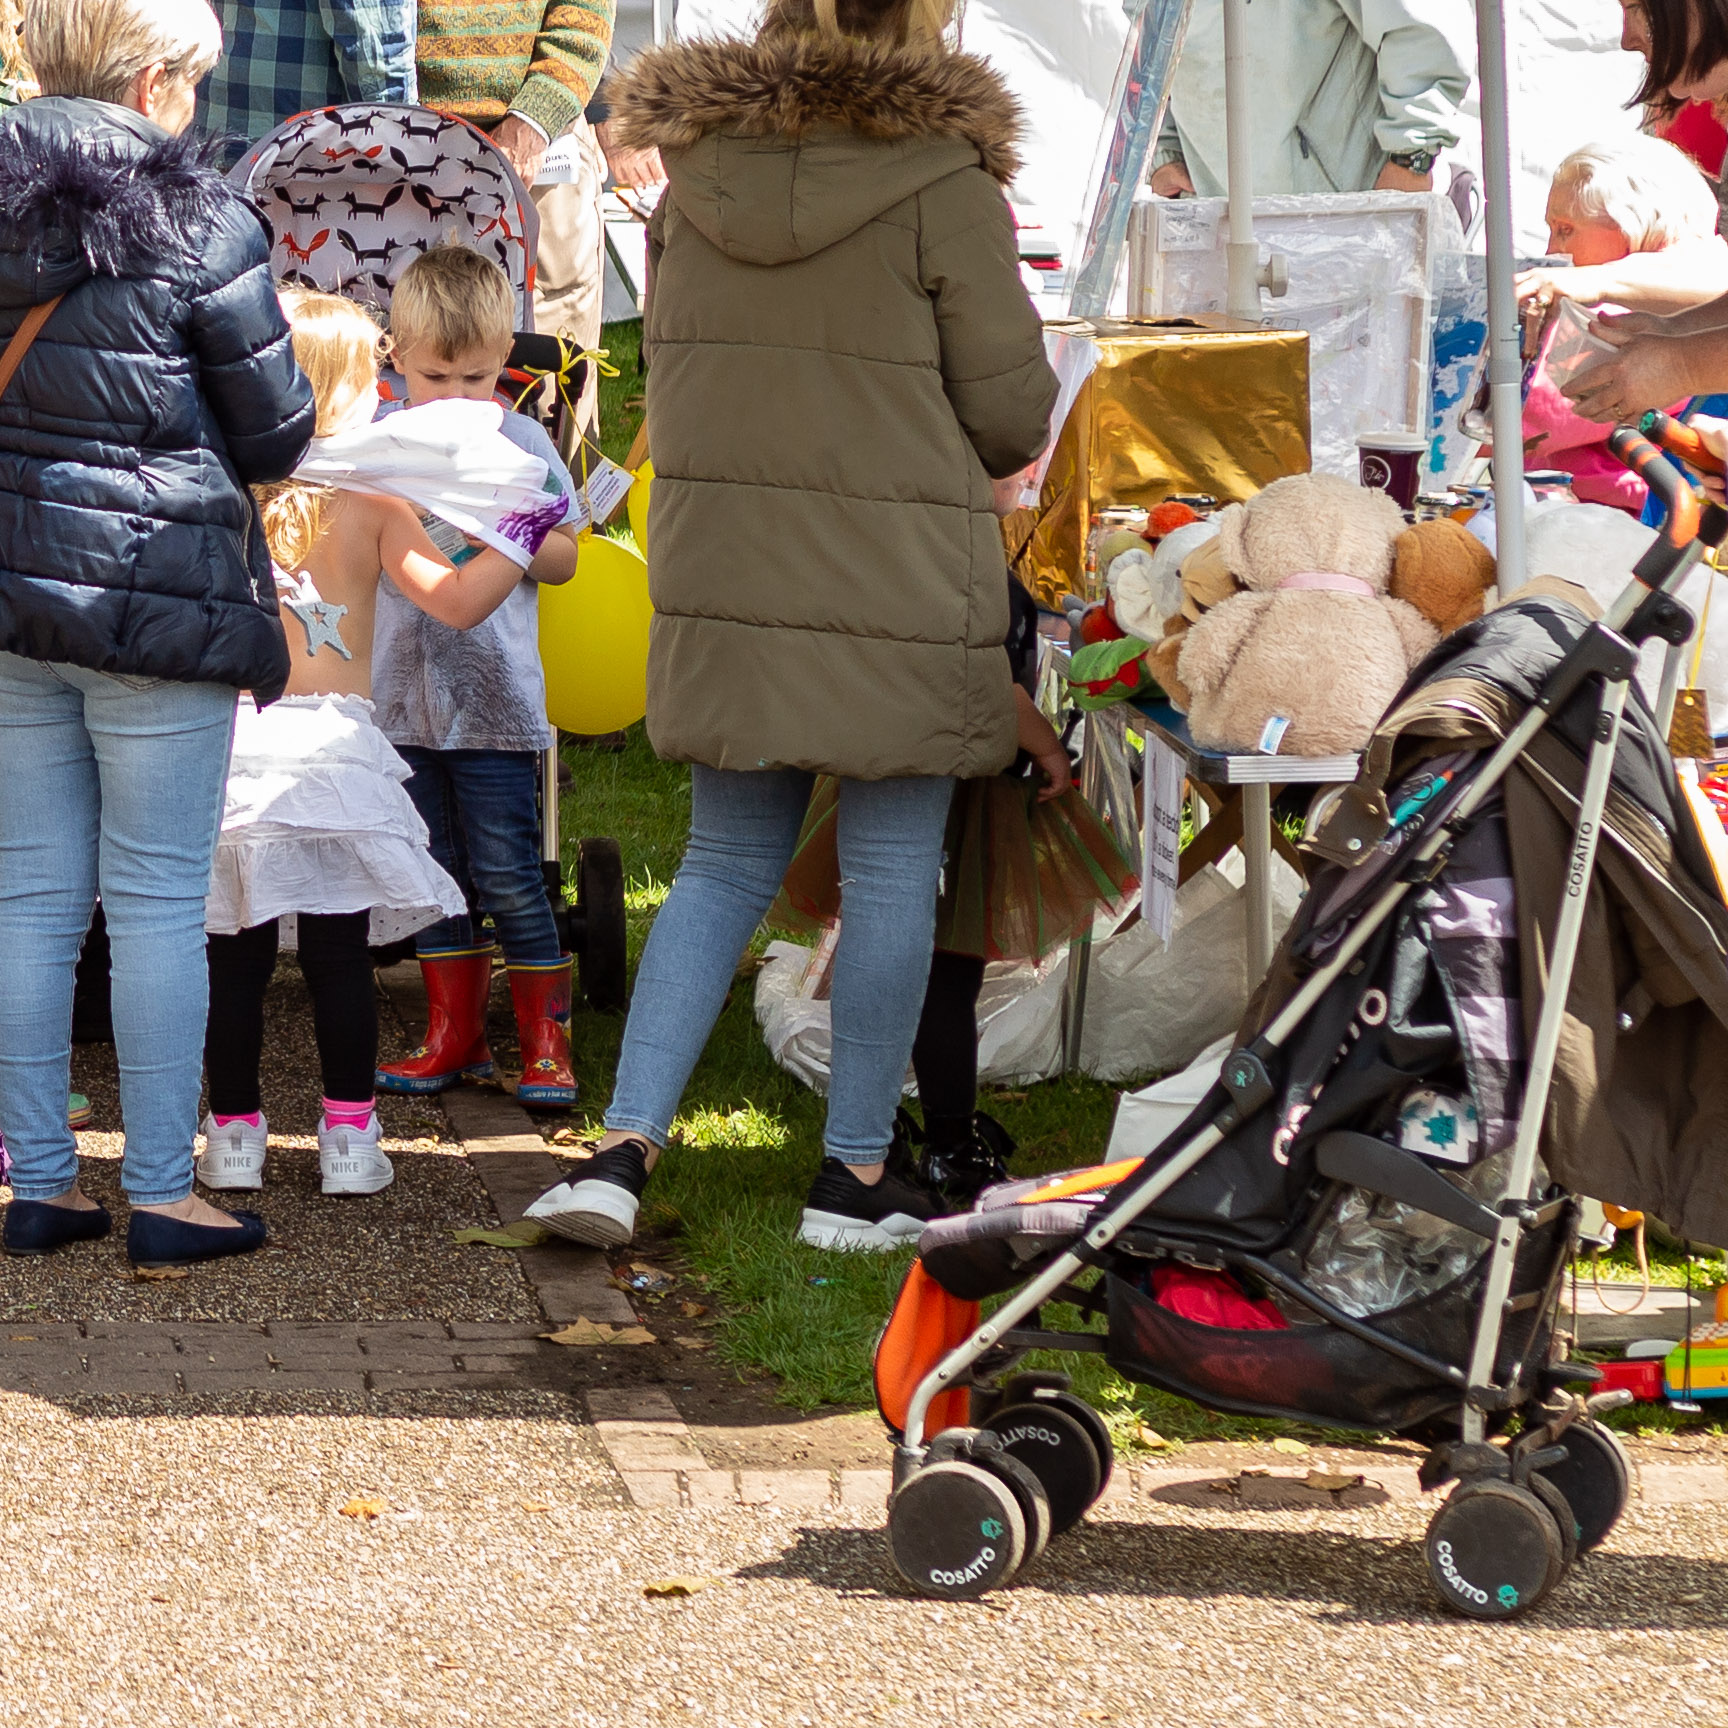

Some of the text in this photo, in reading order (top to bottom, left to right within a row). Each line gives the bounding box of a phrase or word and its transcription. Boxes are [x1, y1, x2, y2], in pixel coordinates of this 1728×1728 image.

[1568, 821, 1594, 898] COSATTO
[223, 1156, 252, 1169] NIKE
[331, 1161, 360, 1174] NIKE
[929, 1546, 996, 1586] COSATTO
[1436, 1540, 1489, 1605] COSATTO
